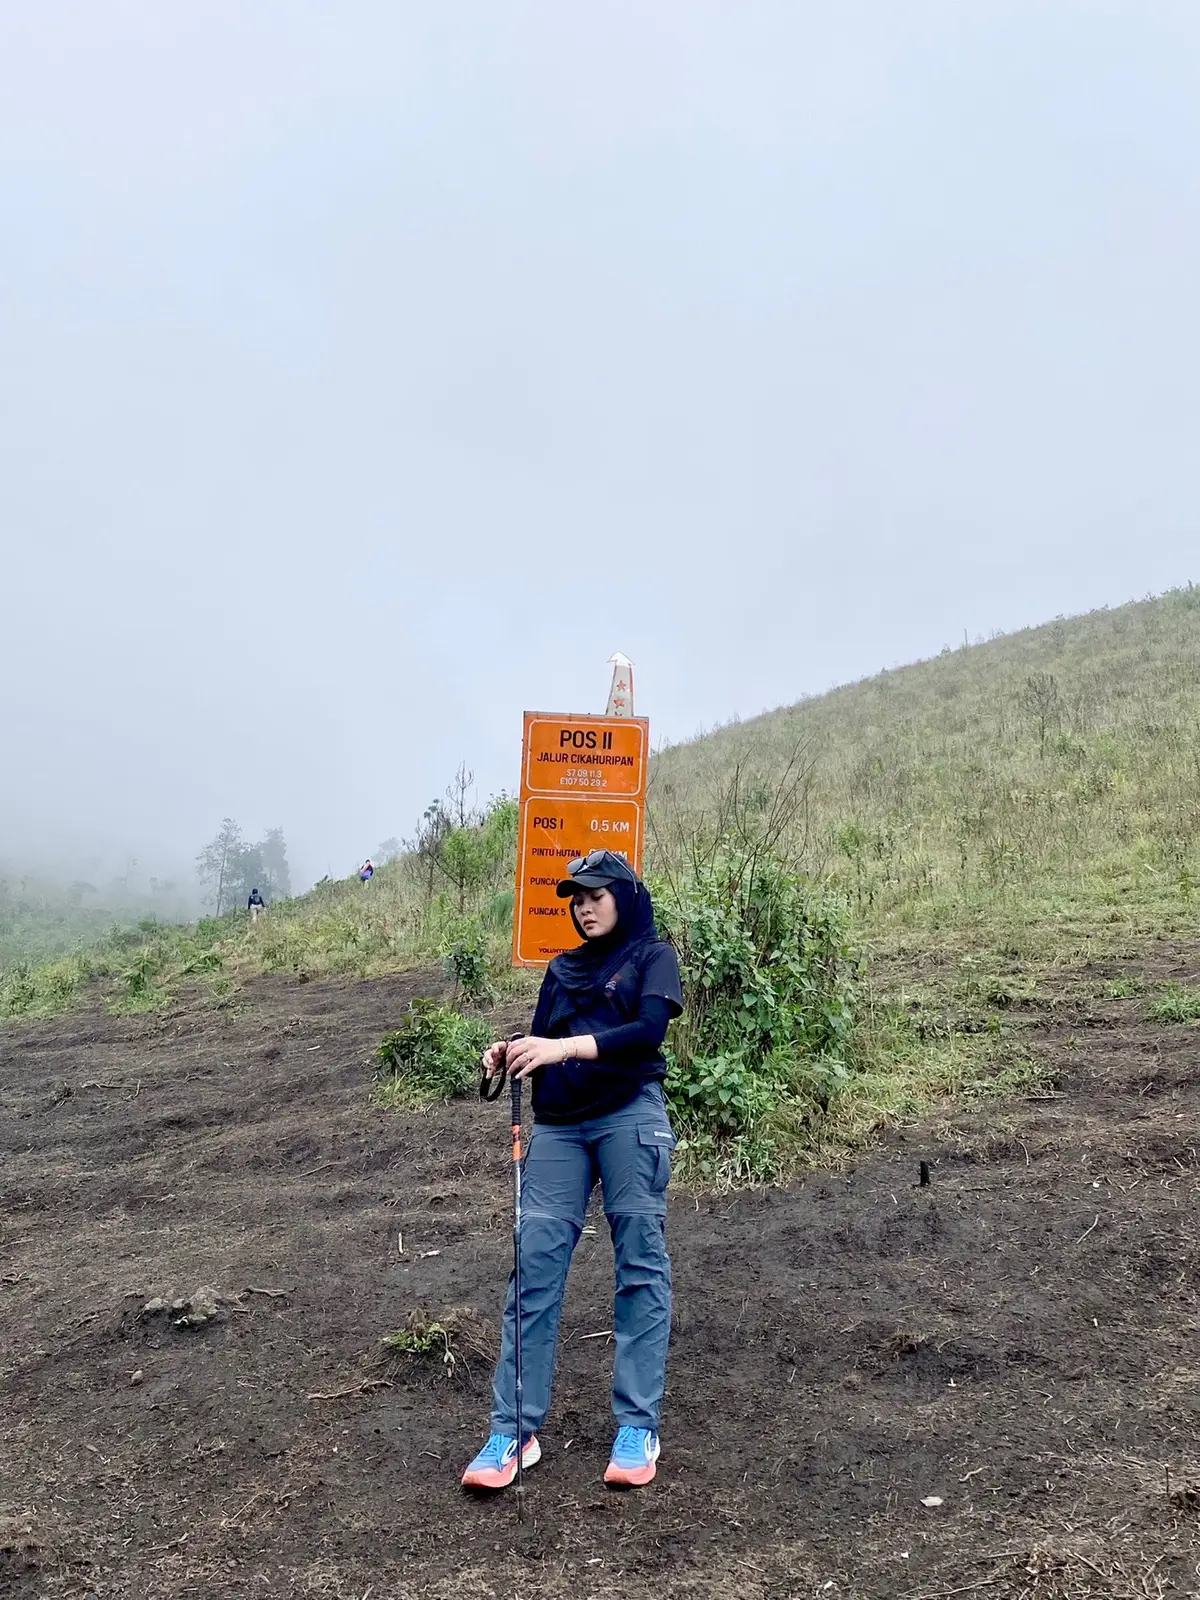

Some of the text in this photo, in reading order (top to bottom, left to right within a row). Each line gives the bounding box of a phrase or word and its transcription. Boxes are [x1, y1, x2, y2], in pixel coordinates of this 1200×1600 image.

[560, 730, 612, 750] POS II
[536, 752, 634, 766] JALUR CIKAHURIPAN
[566, 768, 576, 776] S7
[534, 816, 564, 830] POS I
[612, 821, 630, 832] KM
[532, 848, 554, 856] PINTU
[556, 848, 581, 857] HUTAN
[528, 907, 559, 916] PUNCAK
